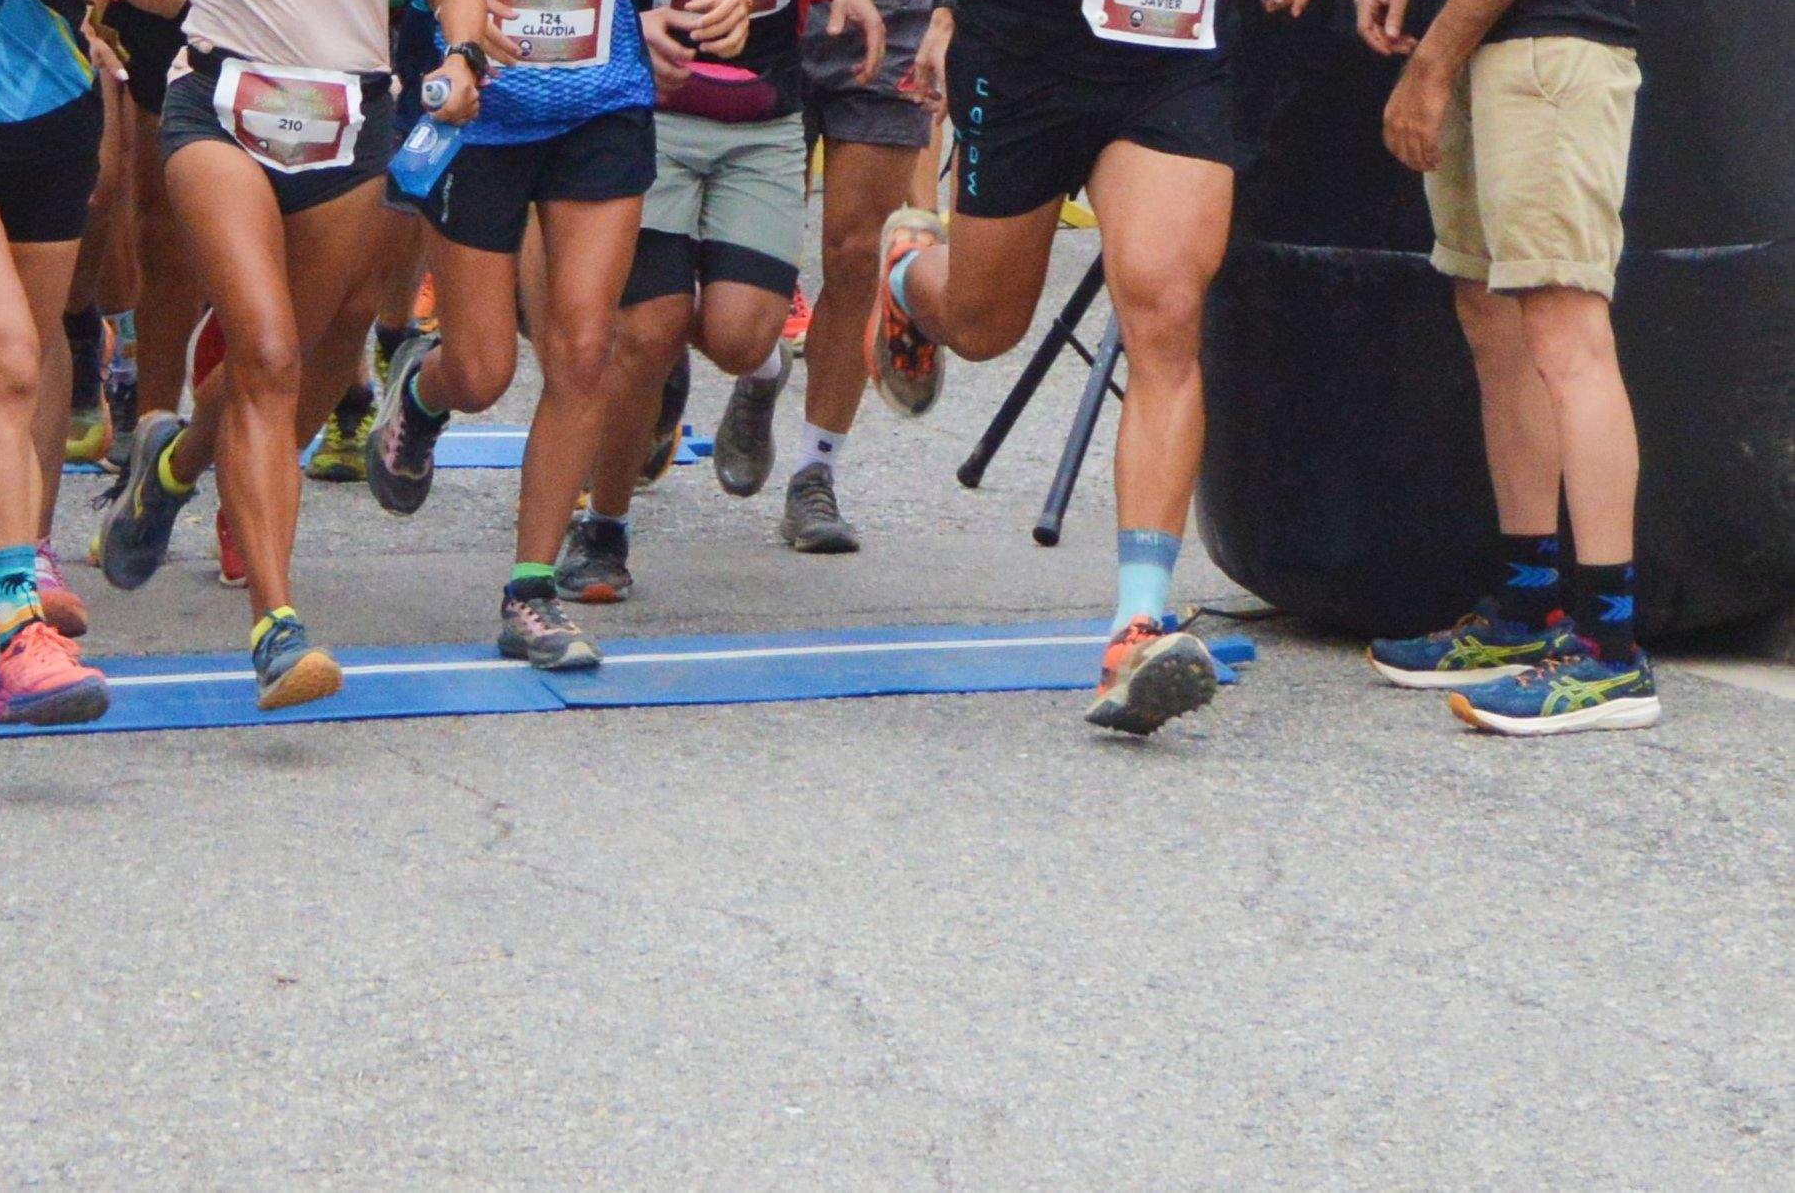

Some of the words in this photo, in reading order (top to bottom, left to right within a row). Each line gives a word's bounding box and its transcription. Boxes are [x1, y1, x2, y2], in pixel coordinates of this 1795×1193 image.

[539, 12, 562, 25] 124
[521, 25, 576, 37] CLAUDIA
[278, 118, 303, 132] 210
